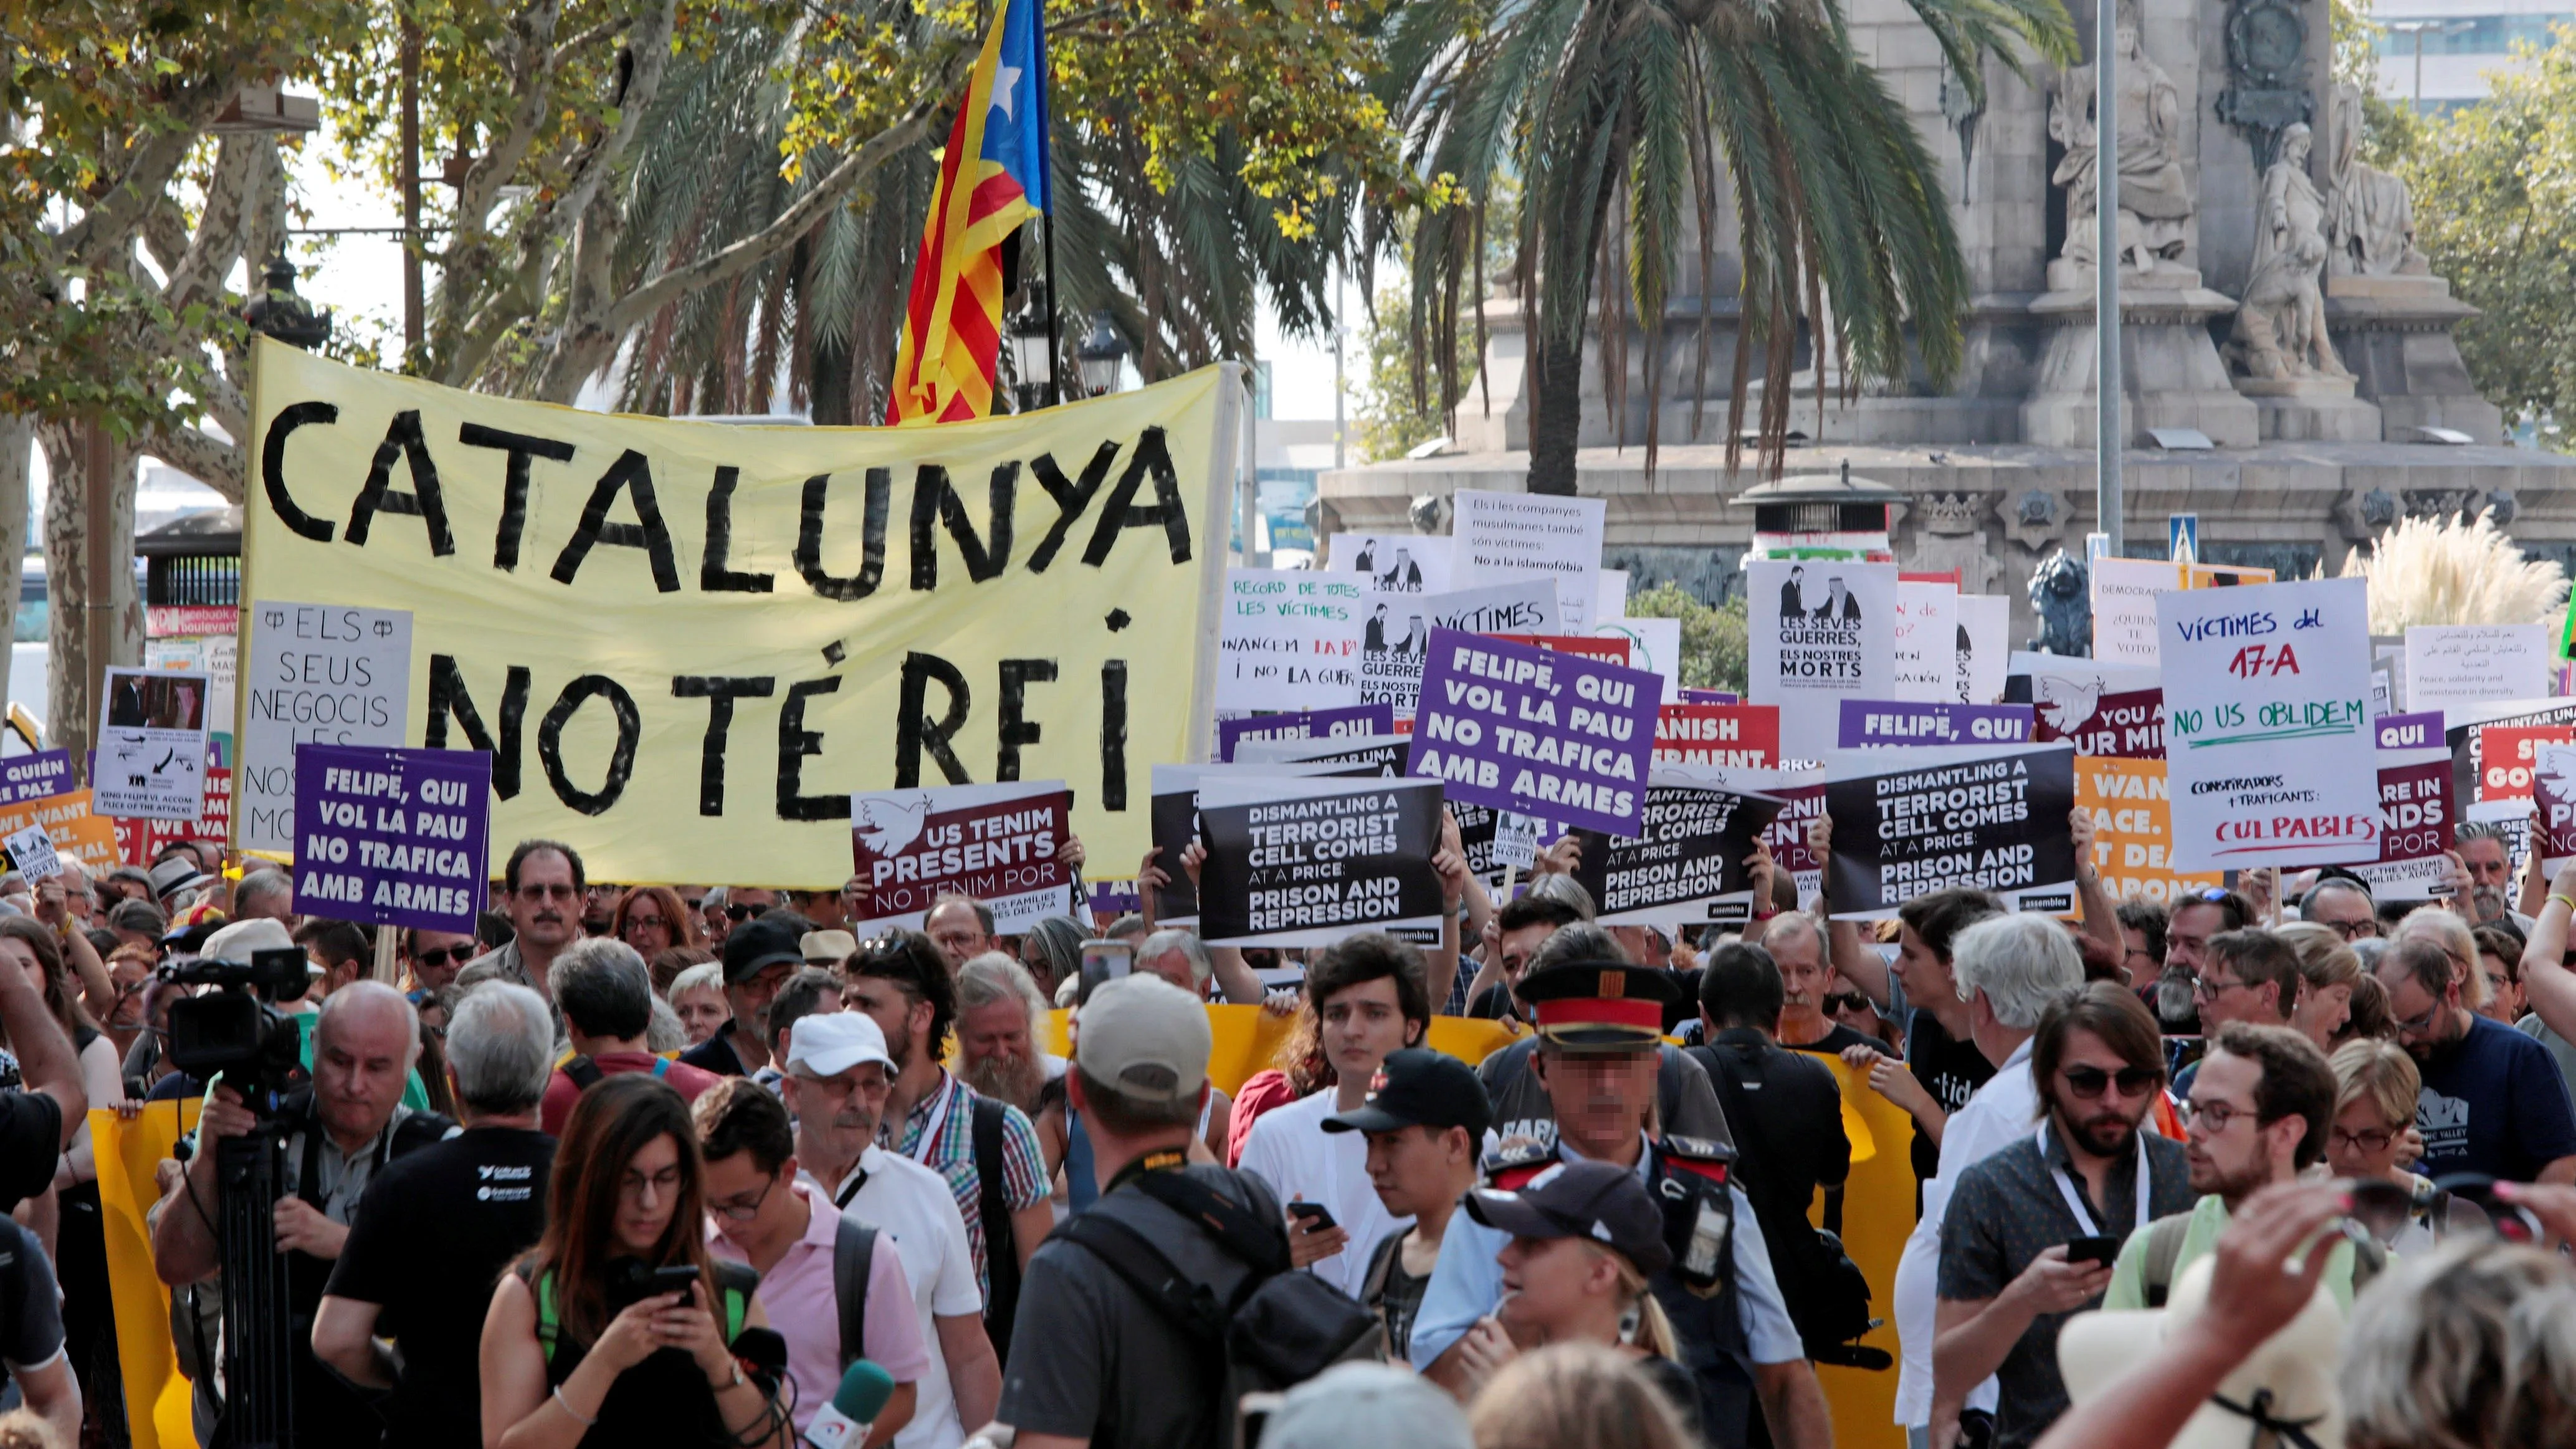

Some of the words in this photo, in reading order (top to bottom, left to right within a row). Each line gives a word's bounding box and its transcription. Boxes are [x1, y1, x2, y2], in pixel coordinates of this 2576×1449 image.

[261, 399, 1191, 603] CATALUNYA
[1474, 499, 1489, 510] Els
[1499, 501, 1514, 511] les
[1517, 504, 1581, 517] companyes
[1472, 519, 1543, 533] musulmanes
[1547, 524, 1584, 536] també
[1472, 537, 1491, 547] són
[1474, 555, 1491, 566] No
[1504, 557, 1514, 567] la
[1517, 557, 1583, 573] islamofòbia
[1234, 580, 1286, 595] RECORD
[1299, 582, 1317, 594] DE
[1324, 583, 1360, 598] TOTES
[1380, 581, 1422, 592] SEVES
[1237, 600, 1266, 616] LES
[1277, 600, 1348, 621] VÍCTIMES
[1435, 601, 1543, 632] VÍCTIMES
[297, 608, 361, 643] ELS
[1780, 617, 1806, 629] LES
[1811, 618, 1861, 631] SEVES
[2129, 629, 2142, 639] TE
[2177, 611, 2277, 642] VÍCTIMES
[1780, 631, 1861, 648] GUERRES,
[2117, 643, 2157, 654] VOTO?
[1363, 651, 1387, 662] LES
[1780, 650, 1800, 661] ELS
[1803, 651, 1861, 661] NOSTRES
[2228, 643, 2300, 680] 17-A
[280, 651, 371, 687] SEUS
[1254, 665, 1277, 677] NO
[1287, 666, 1311, 684] LA
[1453, 646, 1562, 697] FELIPE,
[1576, 674, 1634, 709] QUI
[1780, 662, 1861, 677] MORTS
[2419, 676, 2446, 684] Peace,
[2448, 675, 2485, 684] solidarity
[1361, 680, 1379, 690] ELS
[2419, 687, 2467, 696] coexistence
[252, 689, 388, 727] NEGOCIS
[1445, 679, 1507, 715] VOL
[1519, 696, 1557, 726] LA
[1570, 707, 1633, 742] PAU
[2100, 705, 2145, 728] YOU
[2174, 710, 2203, 738] NO
[2215, 701, 2244, 726] US
[2259, 699, 2364, 727] OBLIDEM
[425, 653, 641, 816] NO
[672, 639, 851, 821] TÉ
[1329, 717, 1373, 737] QUI
[1865, 714, 1960, 742] FELIPE,
[1971, 717, 2023, 740] QUI
[2381, 724, 2425, 747] QUI
[1363, 748, 1396, 762] UNA
[1427, 712, 1481, 747] NO
[1496, 725, 1636, 782] TRAFICA
[6, 758, 65, 782] QUIÉN
[1876, 762, 2008, 796] DISMANTLING
[2013, 758, 2028, 777] A
[18, 780, 55, 799] PAZ
[325, 767, 410, 804] FELIPE,
[420, 779, 467, 807] QUI
[1416, 749, 1499, 789] AMB
[1510, 769, 1633, 818] ARMES
[2418, 777, 2441, 798] IN
[101, 791, 121, 800] KING
[124, 792, 148, 802] FELIPE
[103, 800, 125, 810] PLICE
[127, 801, 137, 810] OF
[141, 802, 155, 811] THE
[156, 803, 192, 815] ATTACKS
[1249, 795, 1379, 824] DISMANTLING
[1383, 793, 1399, 810] A
[1728, 796, 1741, 804] A
[1876, 778, 2029, 821] TERRORIST
[31, 801, 88, 824] WANT
[319, 800, 367, 830] VOL
[376, 807, 407, 835] LA
[416, 813, 467, 840] PAU
[1877, 814, 1938, 841] CELL
[1944, 801, 2029, 831] COMES
[151, 820, 183, 836] WE
[927, 823, 963, 848] US
[969, 806, 1054, 841] TENIM
[1249, 813, 1400, 847] TERRORIST
[1658, 817, 1729, 842] COMES
[2215, 815, 2376, 843] CULPABLES
[1249, 844, 1308, 868] CELL
[1314, 834, 1398, 861] COMES
[1879, 840, 1901, 859] AT
[1906, 839, 1919, 853] A
[1924, 832, 1978, 853] PRICE:
[2388, 830, 2440, 856] POR
[307, 834, 349, 864] NO
[359, 840, 471, 879] TRAFICA
[873, 831, 1056, 888] PRESENTS
[1606, 852, 1623, 868] AT
[1626, 850, 1638, 864] A
[1641, 843, 1683, 861] PRICE:
[1881, 851, 1973, 885] PRISON
[1980, 843, 2035, 870] AND
[1249, 870, 1269, 886] AT
[1274, 869, 1287, 882] A
[1292, 863, 1346, 881] PRICE:
[1605, 863, 1677, 892] PRISON
[1683, 855, 1724, 876] AND
[2362, 868, 2375, 878] OF
[2378, 865, 2398, 875] THE
[2401, 858, 2443, 873] VICTIMS
[2408, 869, 2431, 880] AUG
[300, 871, 363, 902] AMB
[372, 880, 470, 917] ARMES
[875, 889, 912, 914] NO
[920, 873, 996, 904] TENIM
[1005, 862, 1056, 891] POR
[1249, 882, 1340, 911] PRISON
[1347, 876, 1400, 899] AND
[1605, 873, 1722, 911] REPRESSION
[1881, 863, 2034, 905] REPRESSION
[1010, 891, 1057, 908] FAMÍLIES
[1014, 906, 1034, 917] DEL
[1036, 902, 1056, 914] 17-A
[1712, 906, 1745, 914] assemblea
[2025, 897, 2067, 908] assemblea
[1249, 896, 1400, 932] REPRESSION
[2441, 1128, 2468, 1139] VALLEY
